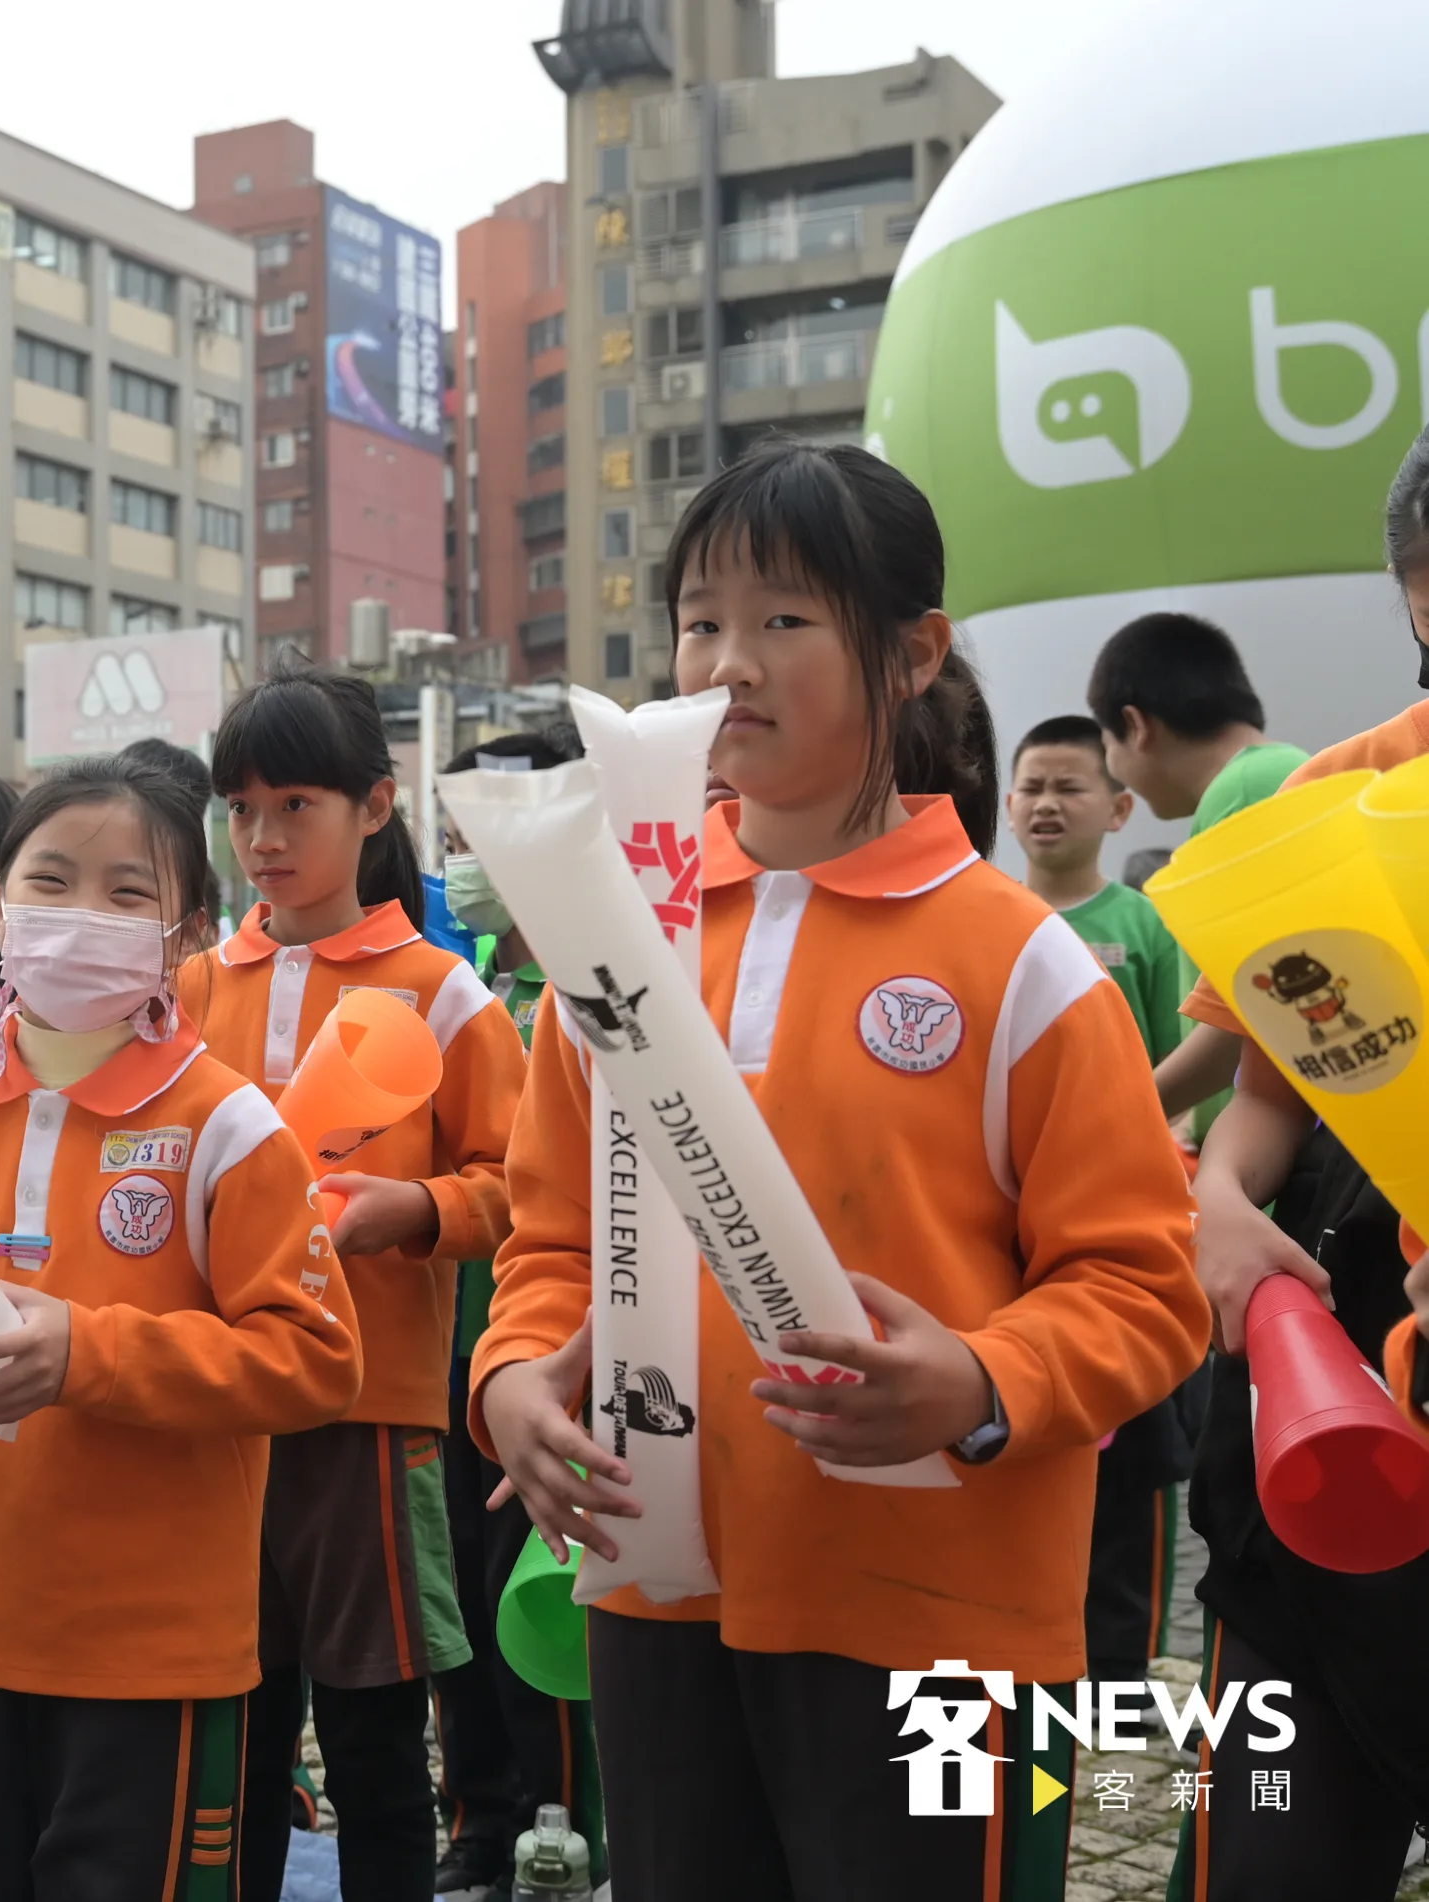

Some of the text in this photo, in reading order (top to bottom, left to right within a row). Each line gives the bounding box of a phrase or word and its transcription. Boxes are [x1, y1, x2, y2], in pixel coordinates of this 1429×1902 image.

[1293, 1016, 1418, 1082] 相信成功
[130, 1214, 143, 1235] 成功
[610, 1110, 638, 1308] EXCELLENCE
[650, 1090, 810, 1333] AIWAN EXCELLENCE
